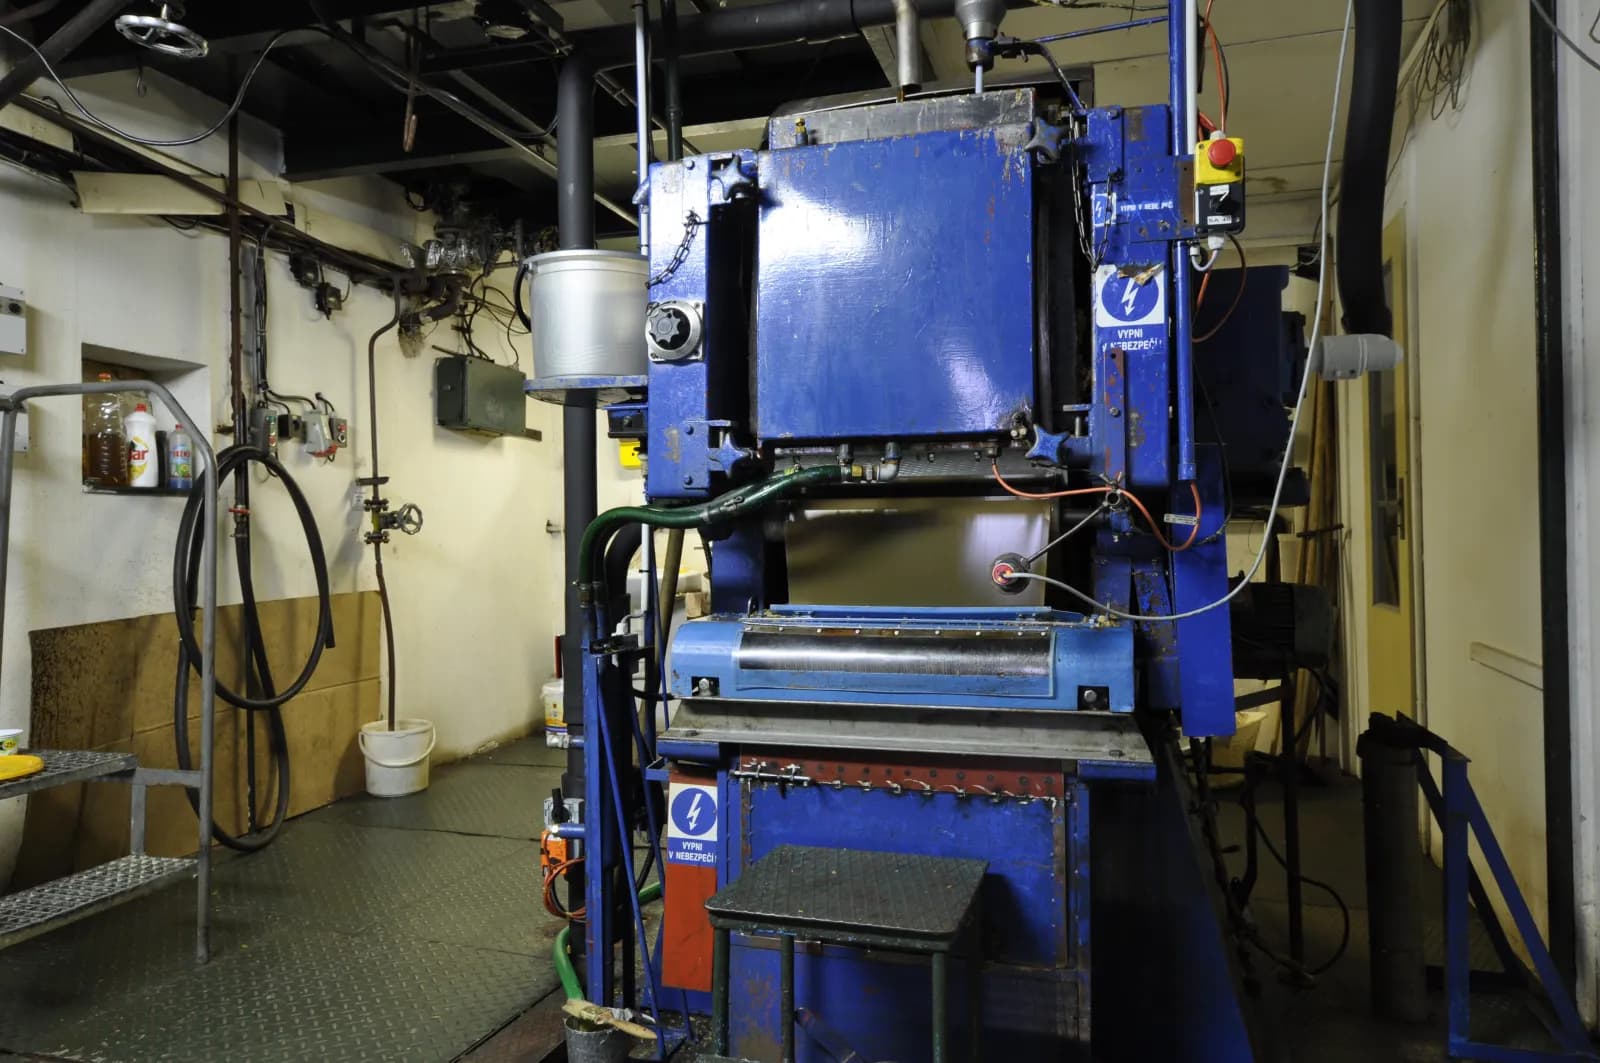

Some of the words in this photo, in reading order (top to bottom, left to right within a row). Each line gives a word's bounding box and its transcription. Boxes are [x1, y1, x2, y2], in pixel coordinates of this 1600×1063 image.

[1117, 327, 1143, 339] VYPNI
[682, 841, 703, 851] VYPNI
[668, 850, 674, 860] V
